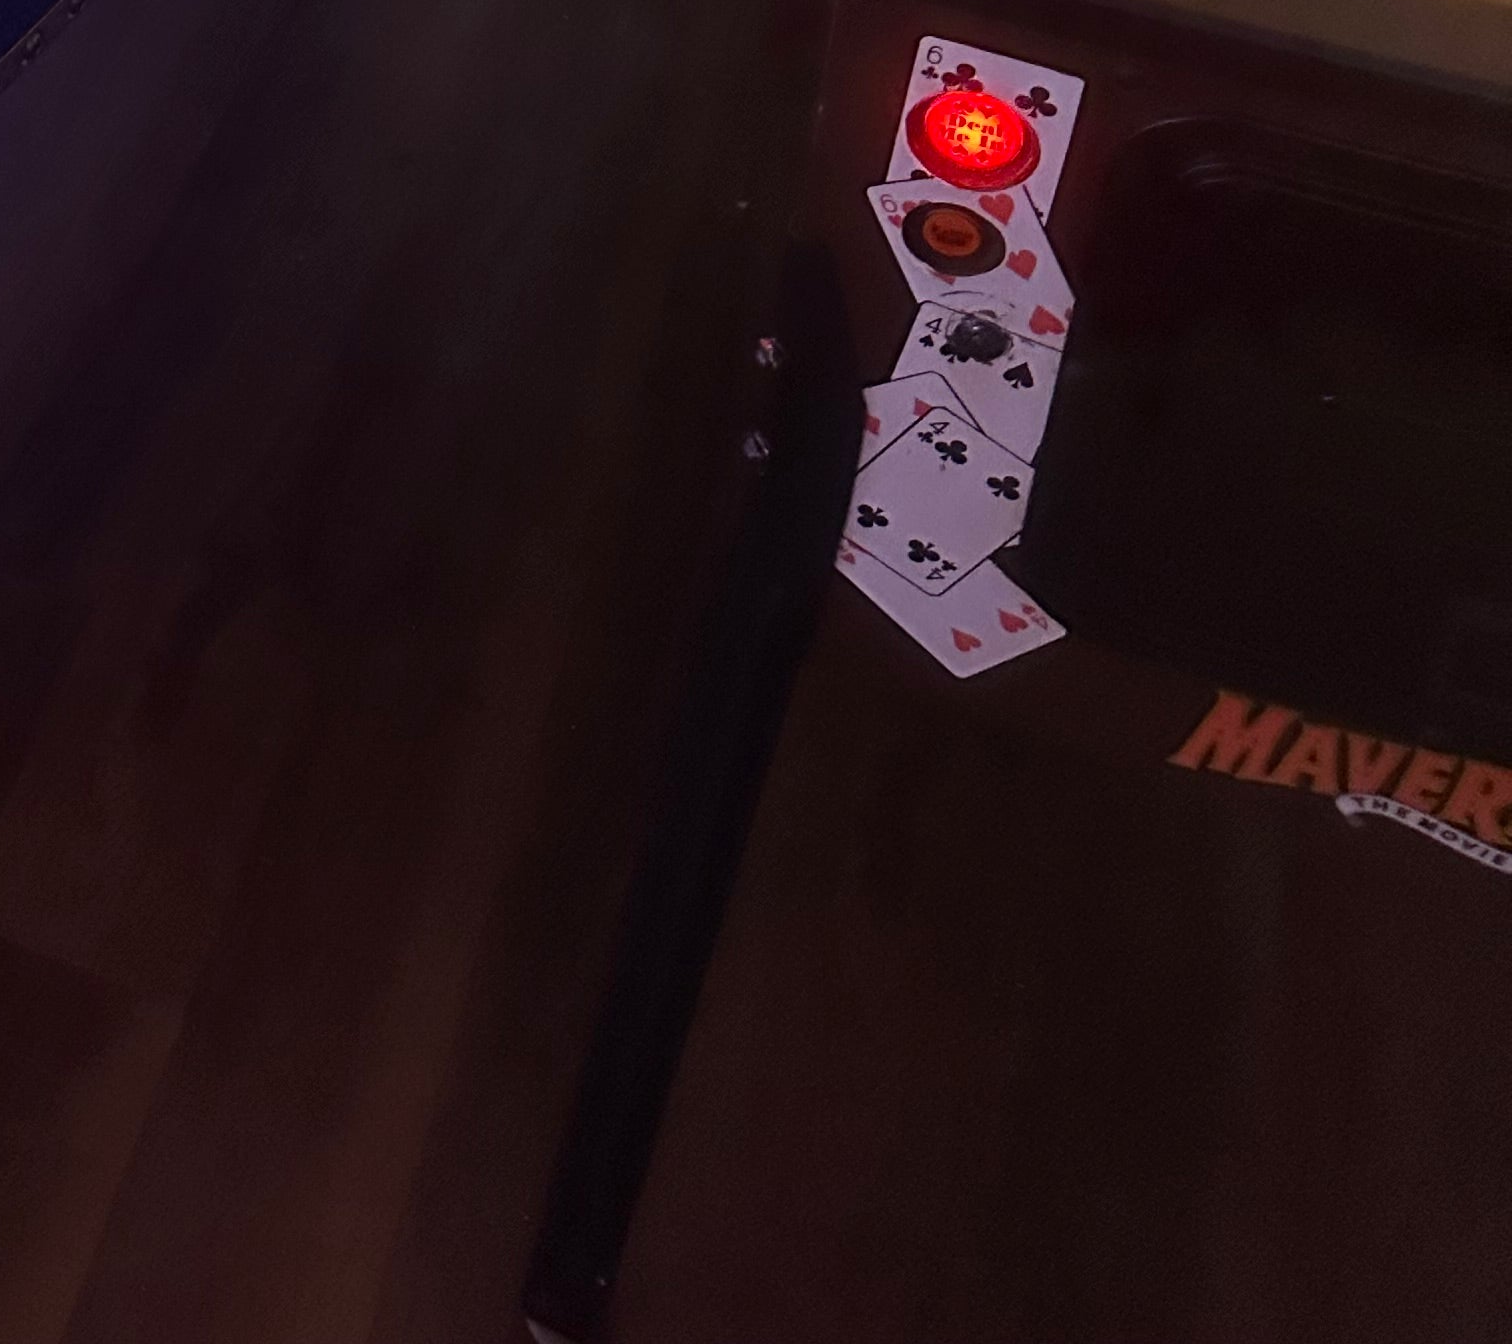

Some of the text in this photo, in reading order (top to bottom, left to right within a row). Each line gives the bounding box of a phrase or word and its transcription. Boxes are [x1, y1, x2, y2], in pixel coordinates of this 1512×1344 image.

[927, 45, 944, 65] 6
[880, 193, 898, 213] 6
[925, 317, 944, 334] 4
[929, 421, 950, 435] 4
[1350, 794, 1512, 868] THE MOVIE
